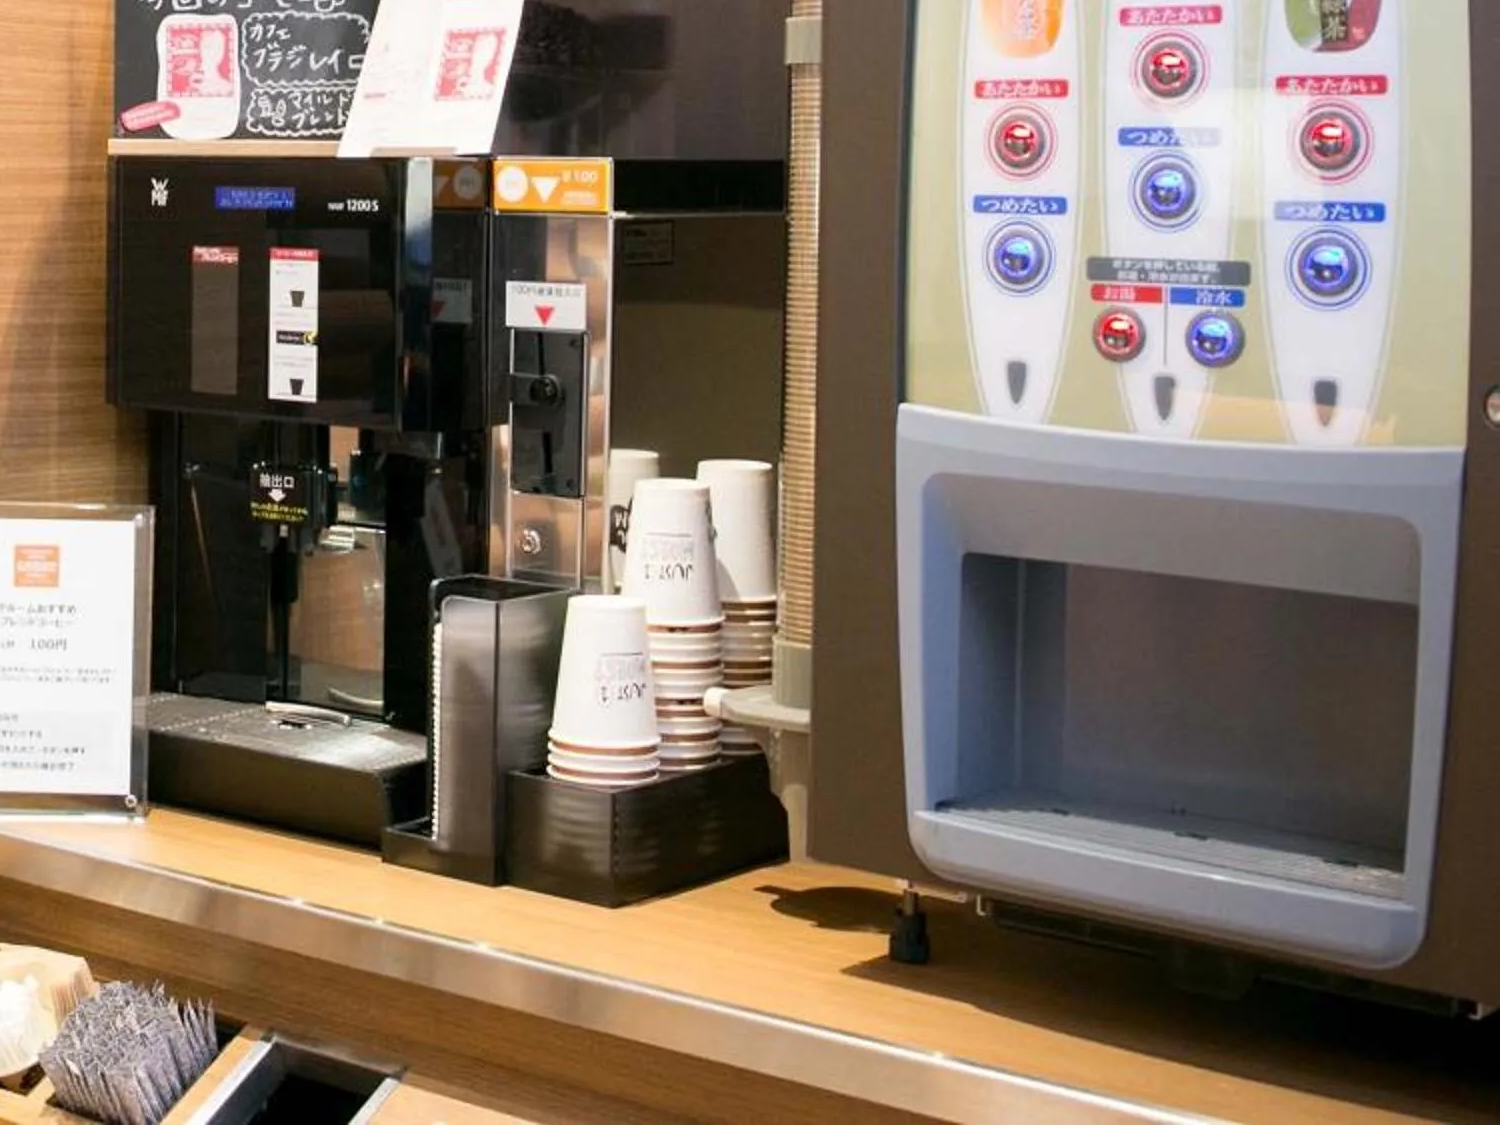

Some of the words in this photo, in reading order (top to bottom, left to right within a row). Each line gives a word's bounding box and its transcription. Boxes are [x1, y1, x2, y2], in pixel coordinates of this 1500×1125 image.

[1126, 8, 1216, 24] あたたかい
[250, 24, 291, 41] カフェ
[984, 81, 1062, 96] あたたかい
[1286, 78, 1379, 93] あたたかい
[981, 199, 1059, 214] つめたい
[1283, 205, 1376, 220] つめたい
[1196, 290, 1232, 305] 冷水
